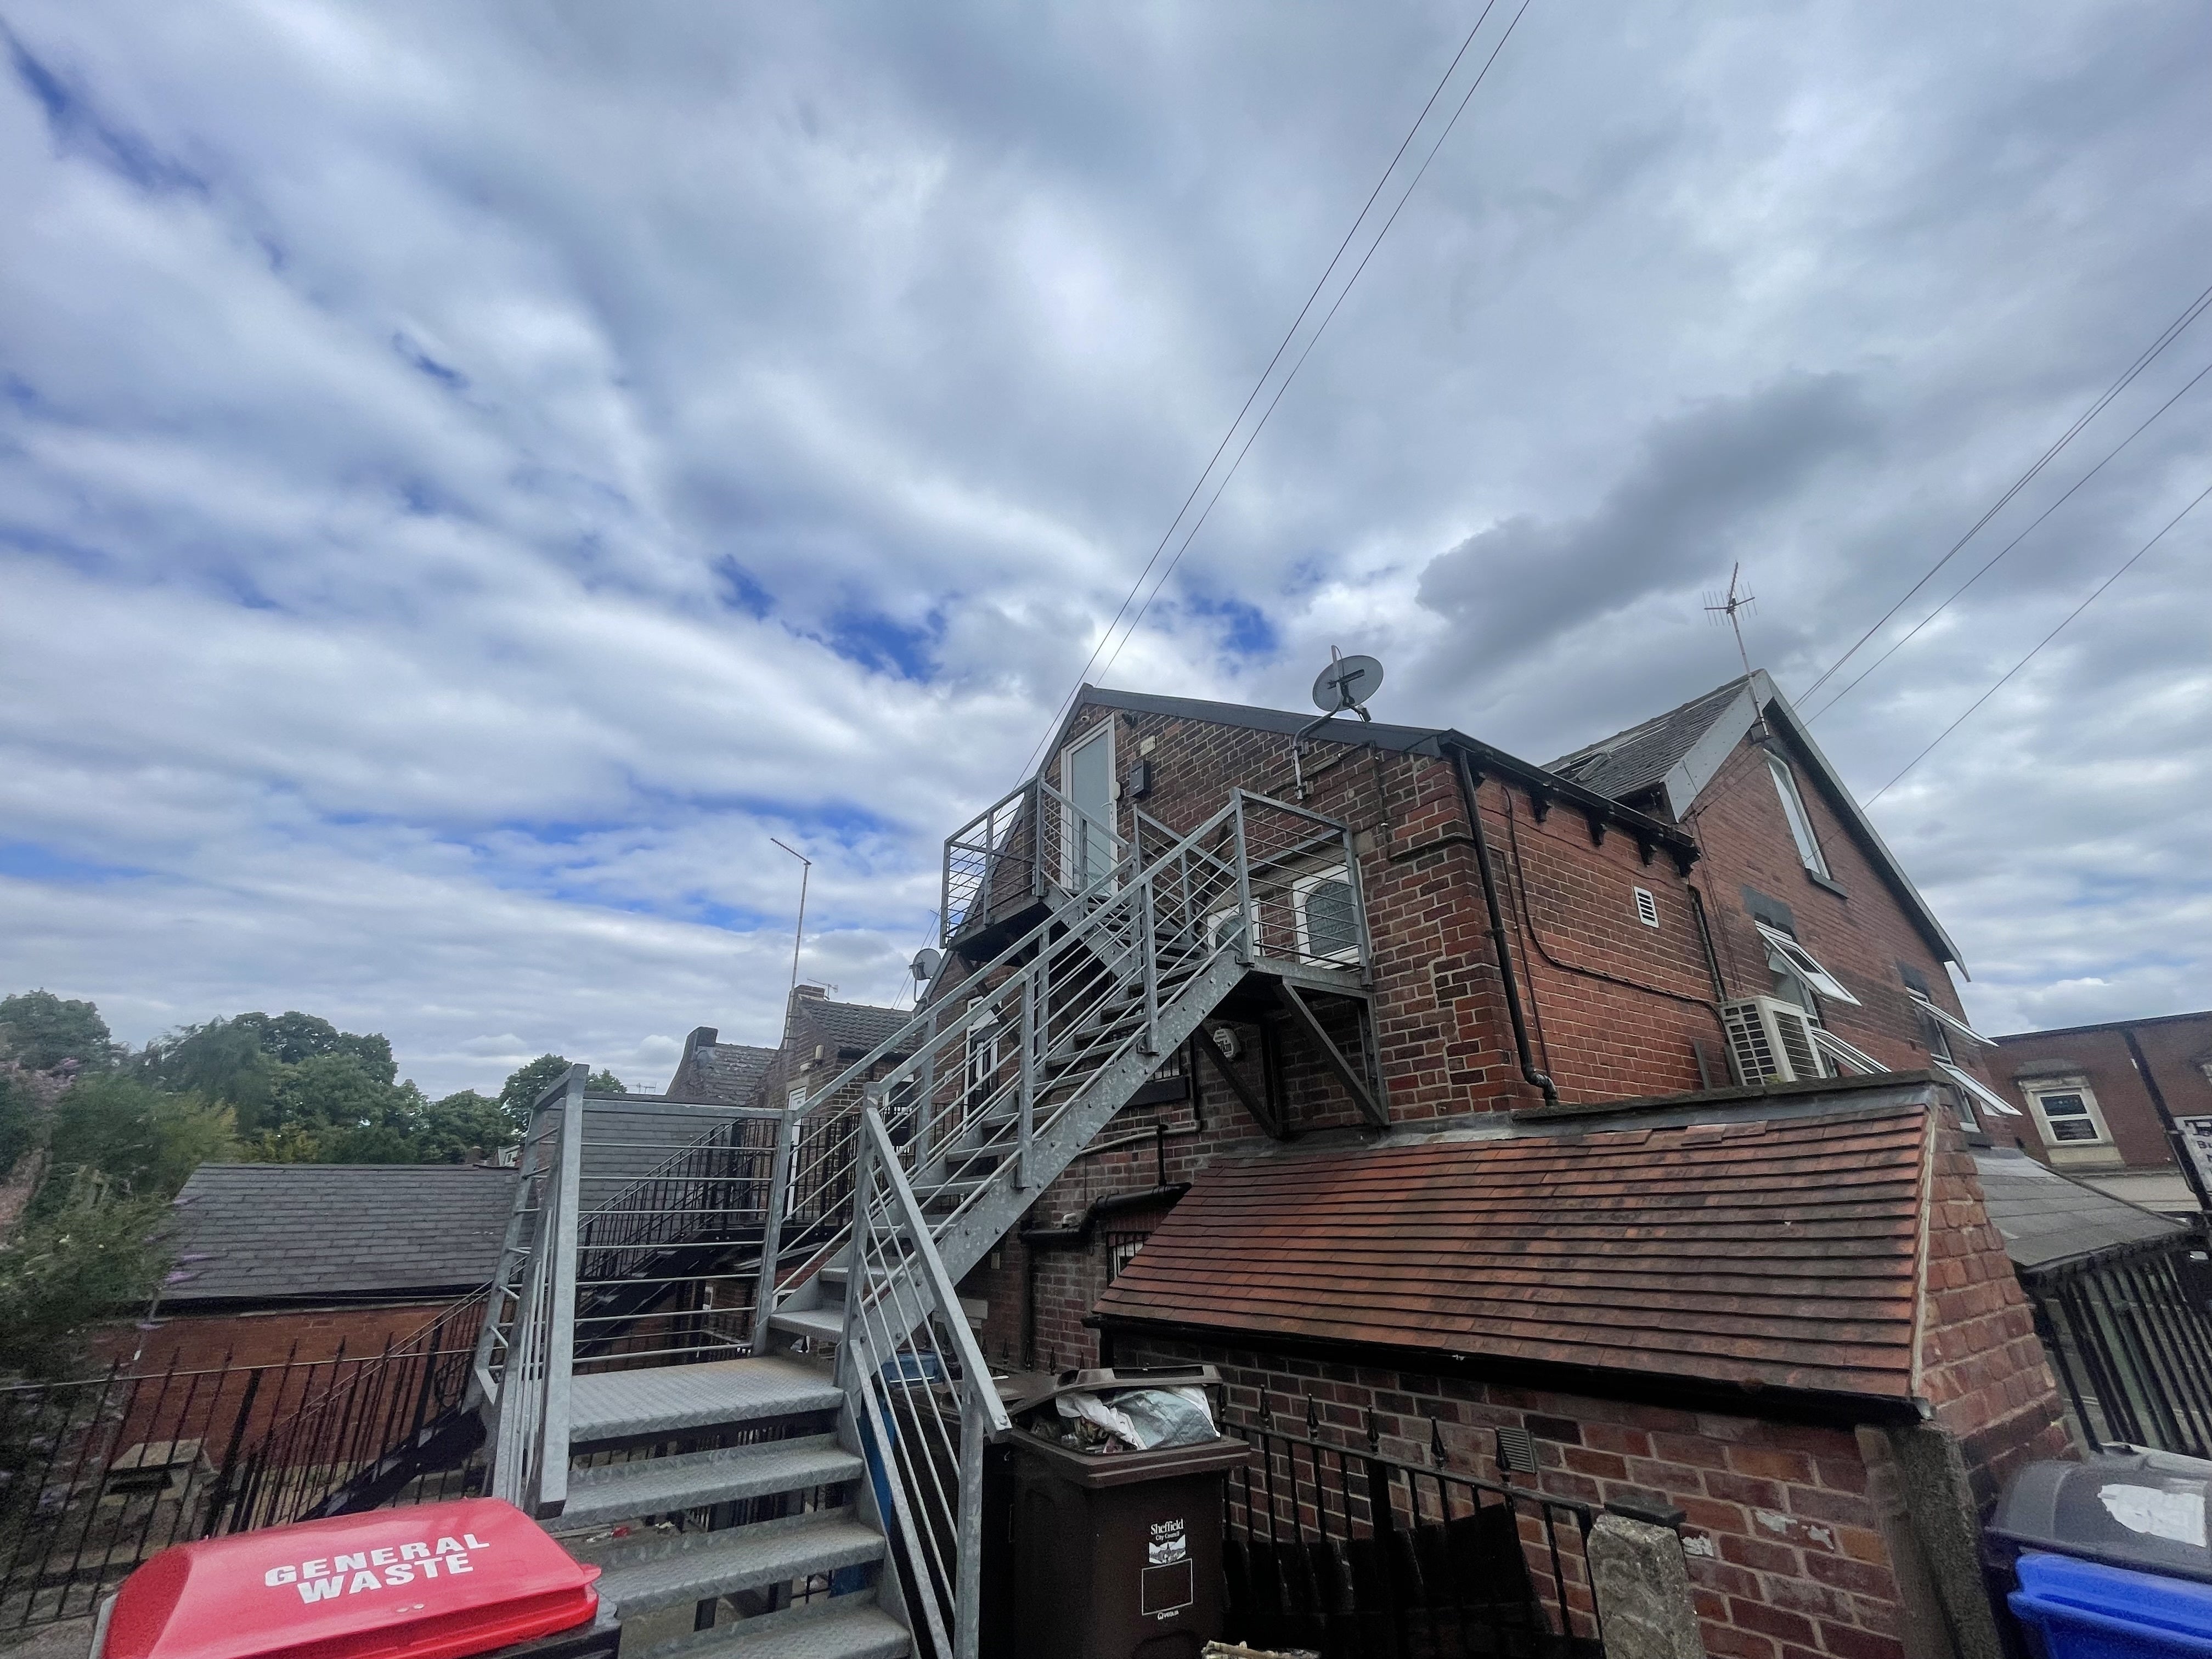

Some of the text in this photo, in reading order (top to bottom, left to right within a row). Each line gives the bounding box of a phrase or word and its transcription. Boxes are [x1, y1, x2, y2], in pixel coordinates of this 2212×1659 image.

[1151, 1518, 1183, 1534] Sheffield
[265, 1534, 490, 1587] GENERAL
[297, 1553, 473, 1604] WASTE
